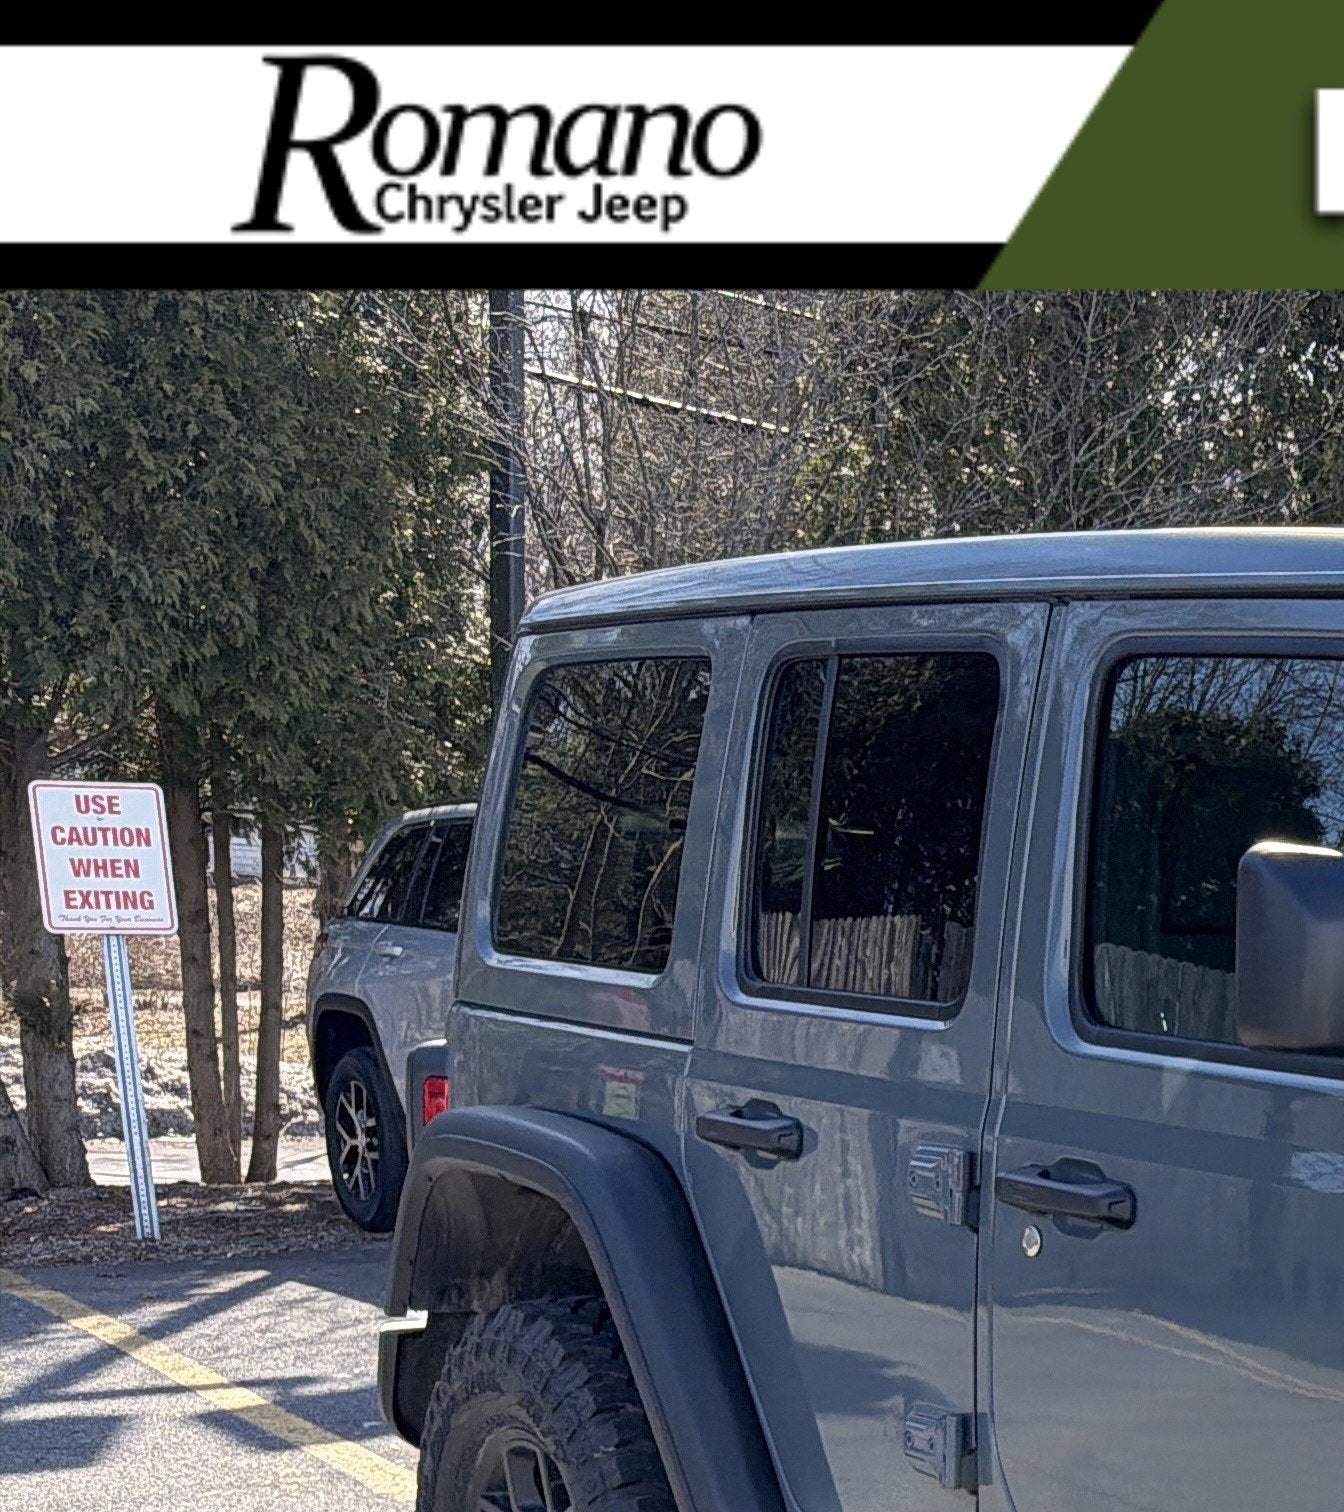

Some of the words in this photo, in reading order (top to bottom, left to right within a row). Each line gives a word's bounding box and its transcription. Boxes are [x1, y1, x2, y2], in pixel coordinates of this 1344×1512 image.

[74, 794, 122, 815] USE
[51, 825, 152, 847] CAUTION
[69, 858, 141, 878] WHEN
[63, 889, 155, 910] EXITING
